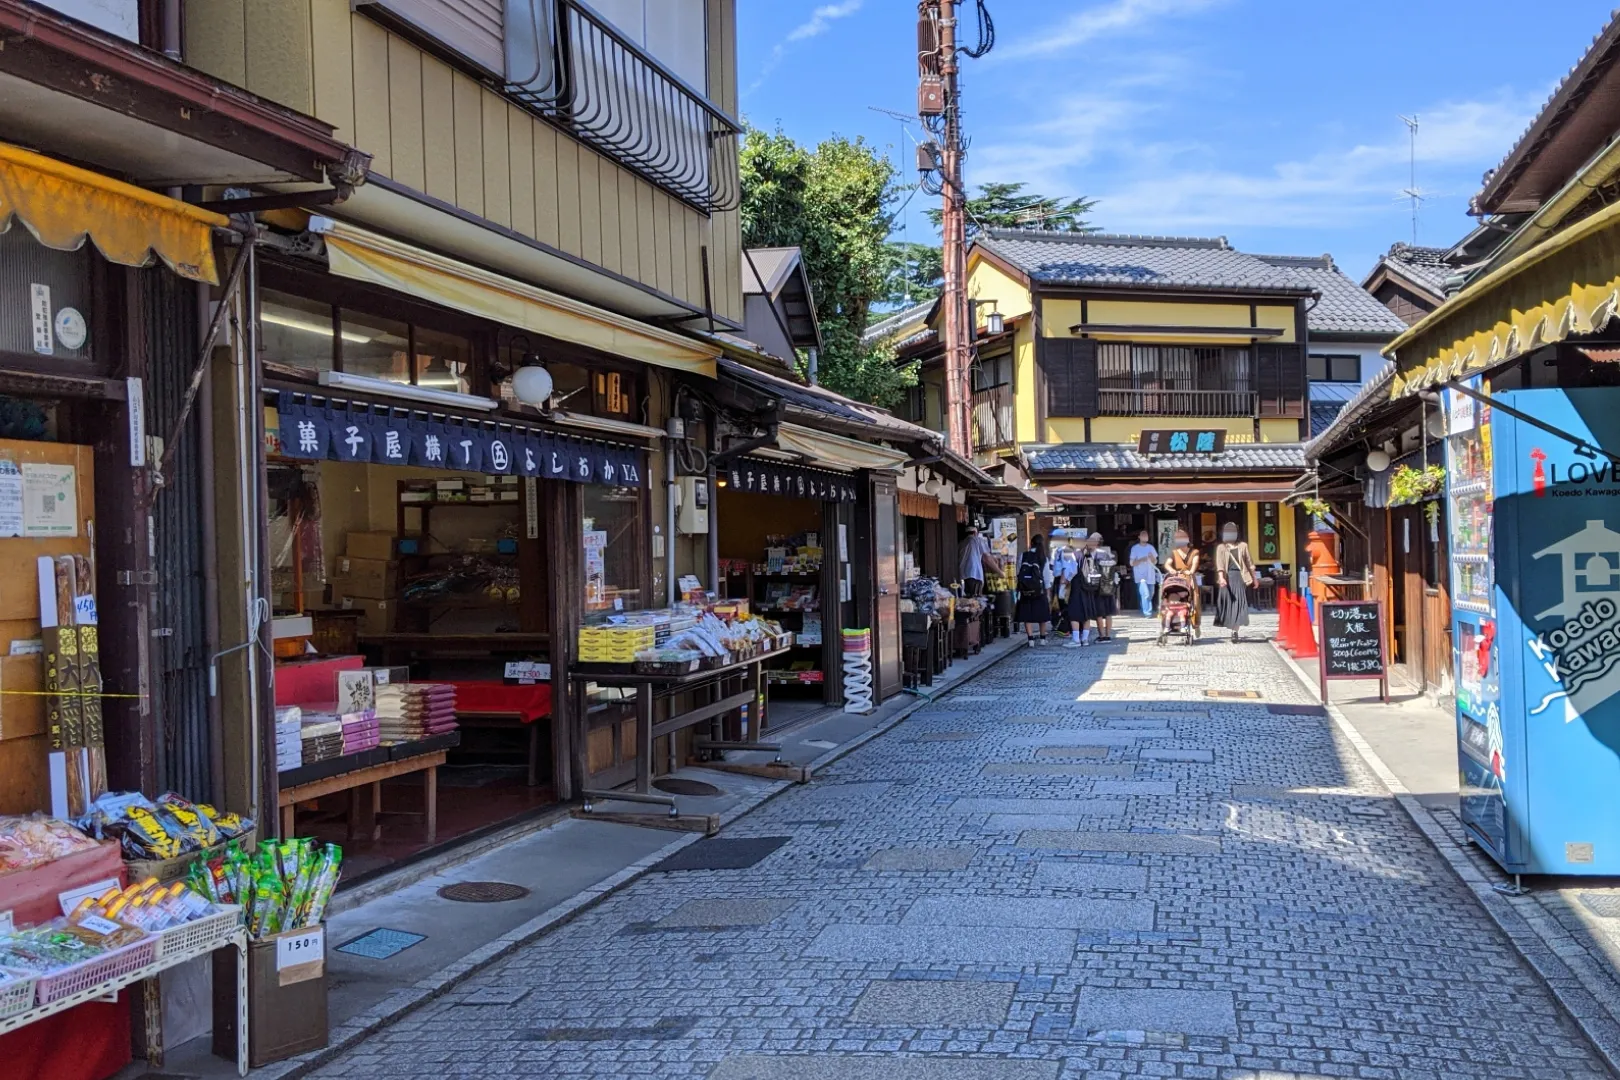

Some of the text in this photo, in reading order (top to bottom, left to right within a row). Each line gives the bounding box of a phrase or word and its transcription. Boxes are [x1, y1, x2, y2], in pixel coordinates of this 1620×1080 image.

[1552, 488, 1583, 497] Koedo
[1263, 522, 1276, 554] あめ
[1330, 606, 1376, 620] 切り落とし
[1345, 622, 1371, 634] 大根
[1527, 600, 1615, 661] Koedo
[288, 938, 318, 951] 150円
